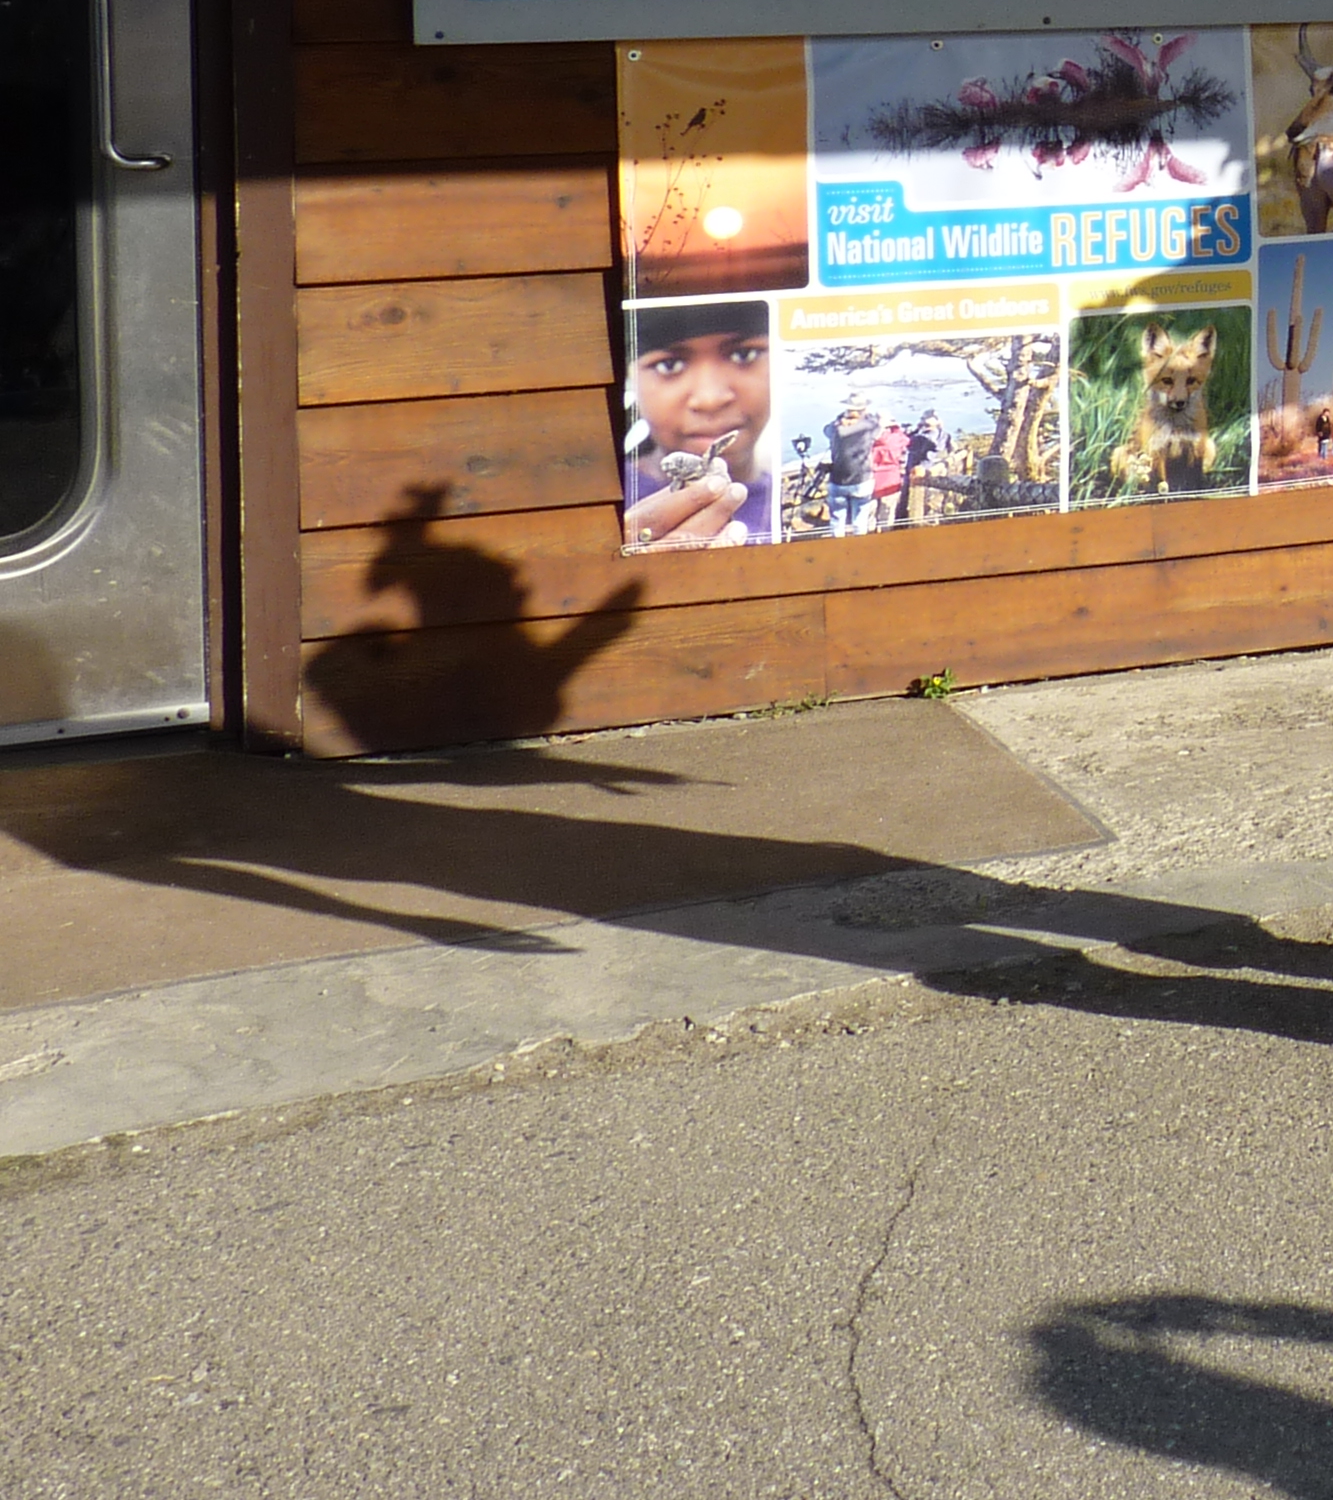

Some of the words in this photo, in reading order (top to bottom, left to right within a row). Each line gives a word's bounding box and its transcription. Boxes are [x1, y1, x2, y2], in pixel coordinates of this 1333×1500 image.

[826, 195, 895, 226] visit
[826, 226, 934, 266] National
[941, 221, 1044, 260] Wildlife
[1050, 203, 1241, 268] REFUGES
[790, 304, 893, 331] America's
[897, 300, 955, 324] Great
[958, 297, 1050, 320] Outdoors
